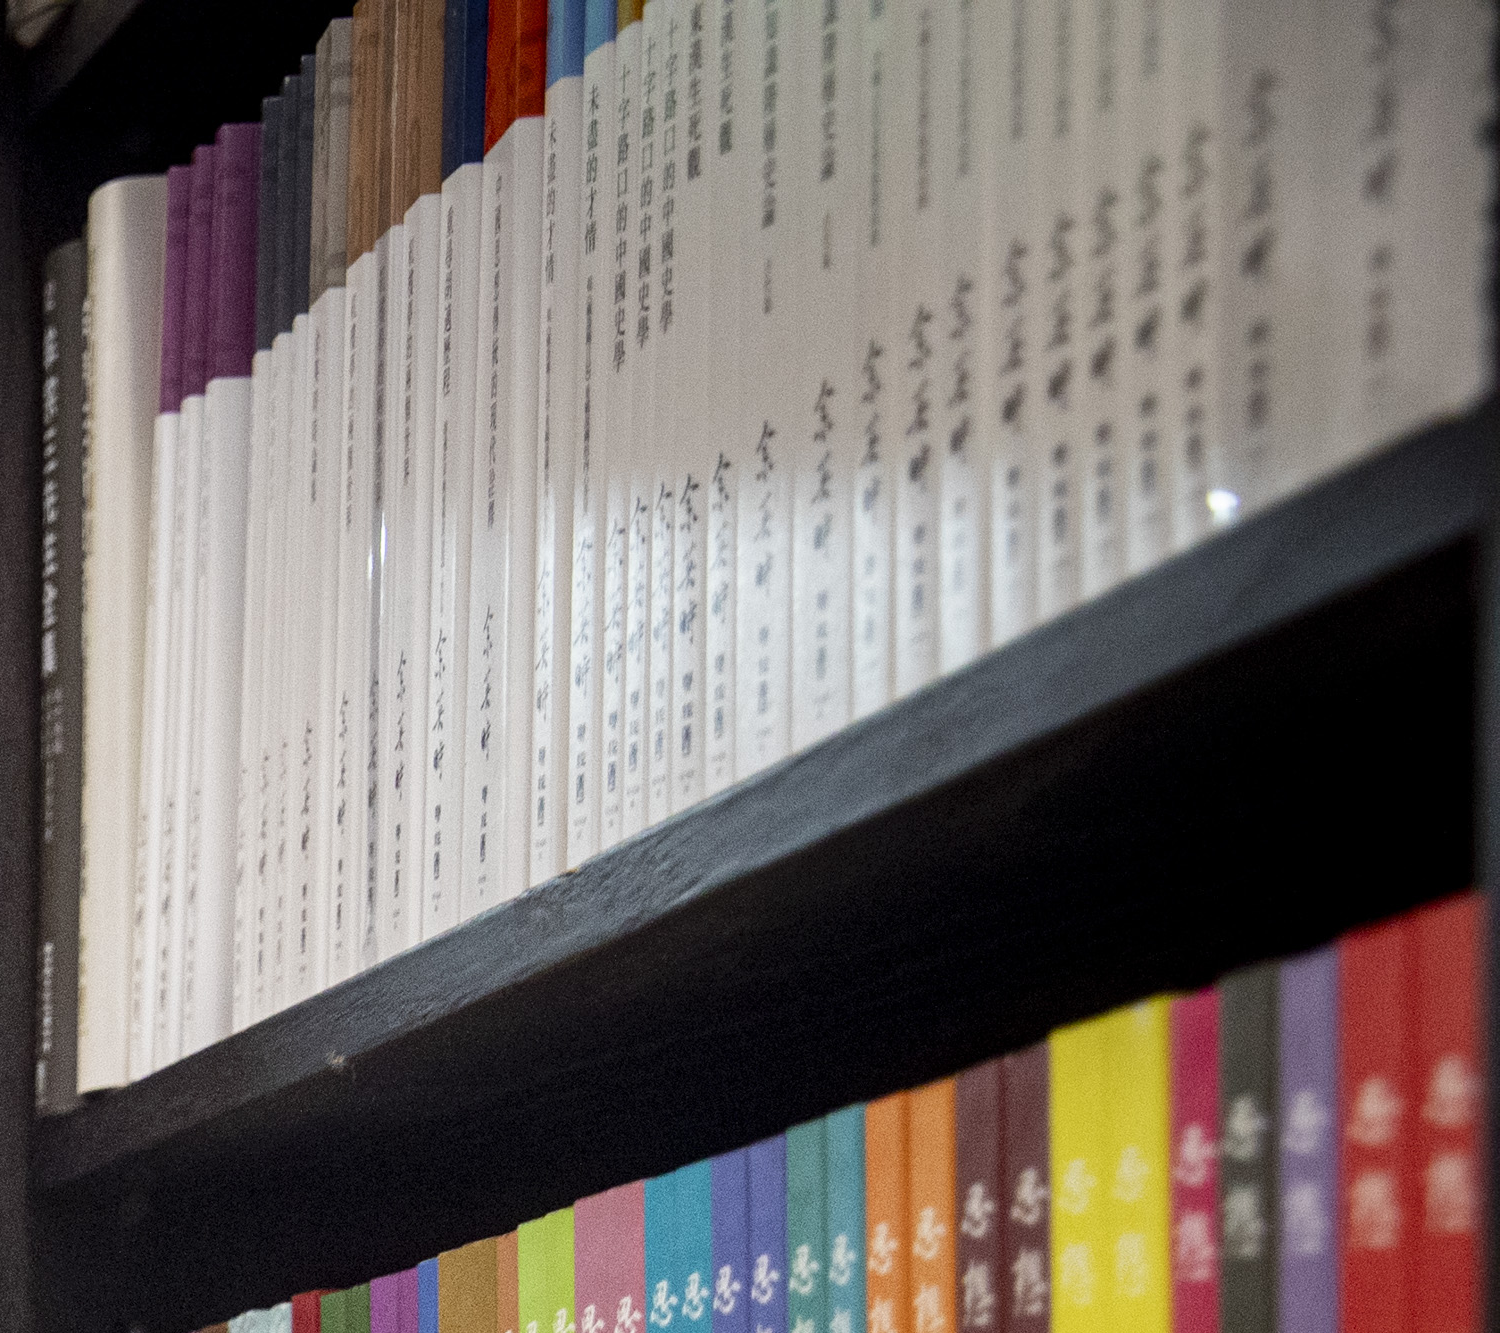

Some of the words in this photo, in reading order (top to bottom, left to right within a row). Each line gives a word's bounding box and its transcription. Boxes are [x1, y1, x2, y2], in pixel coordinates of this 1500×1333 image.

[584, 83, 599, 256] 未盡的才情
[613, 64, 630, 374] 十字路口的中國史學
[636, 36, 655, 348] 十字路口的中國史學
[660, 17, 677, 334] 十字路口的中國史學
[962, 1182, 994, 1328] 思想
[1011, 1168, 1048, 1317] 思想
